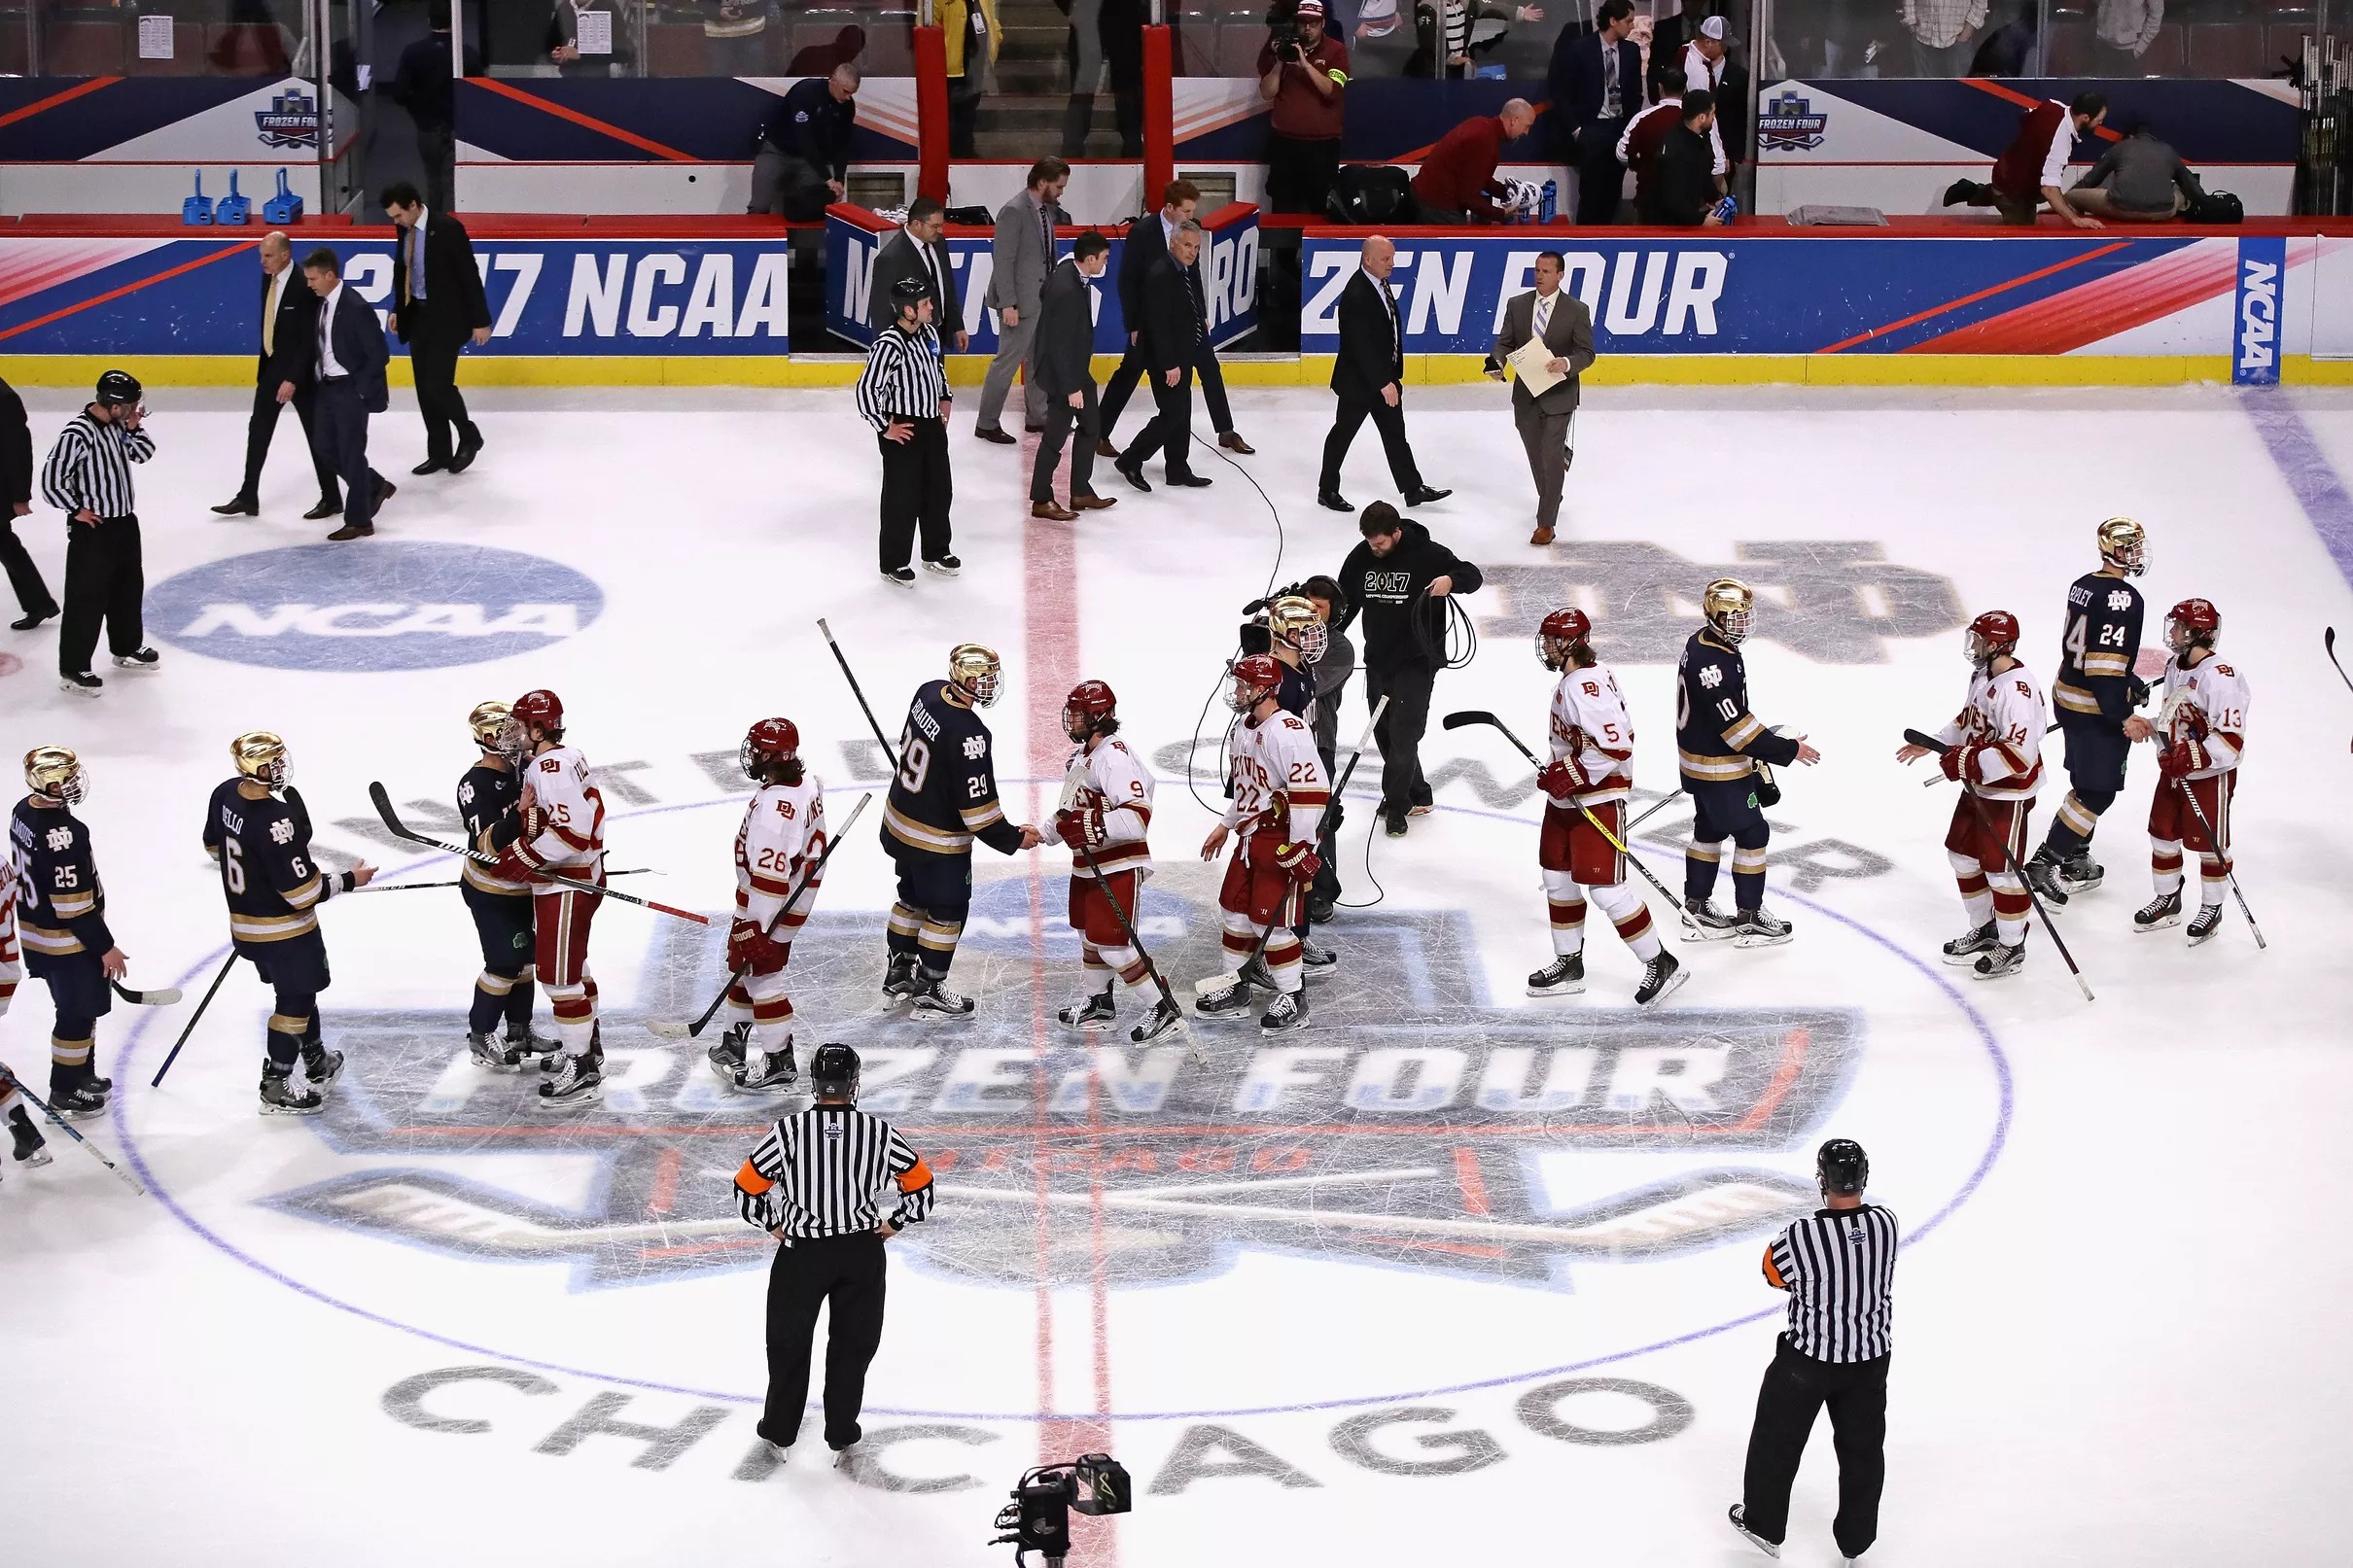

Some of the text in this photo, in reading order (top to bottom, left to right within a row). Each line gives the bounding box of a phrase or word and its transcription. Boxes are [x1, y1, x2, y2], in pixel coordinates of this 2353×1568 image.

[263, 117, 300, 127] FROZEN
[1759, 119, 1821, 129] FROZEN FOUR
[563, 253, 789, 337] NCAA
[2240, 259, 2277, 369] NCAA
[179, 602, 584, 638] NCAA
[2062, 609, 2089, 671] 4
[2099, 623, 2126, 647] 24
[910, 697, 941, 742] BRAUER
[1715, 697, 1738, 722] 10
[2223, 707, 2242, 729] 13
[1603, 722, 1619, 743] 5
[2006, 722, 2027, 748] 14
[967, 773, 989, 799] 29
[1289, 762, 1317, 784] 22
[1130, 780, 1145, 799] 9
[1235, 783, 1261, 813] 22
[225, 836, 247, 895] 6
[292, 855, 308, 879] 6
[757, 847, 787, 873] 26
[54, 864, 78, 889] 25
[1641, 867, 1664, 889] CCM
[1230, 1045, 1733, 1113] FOUR
[379, 1365, 1698, 1499] CHICAGO
